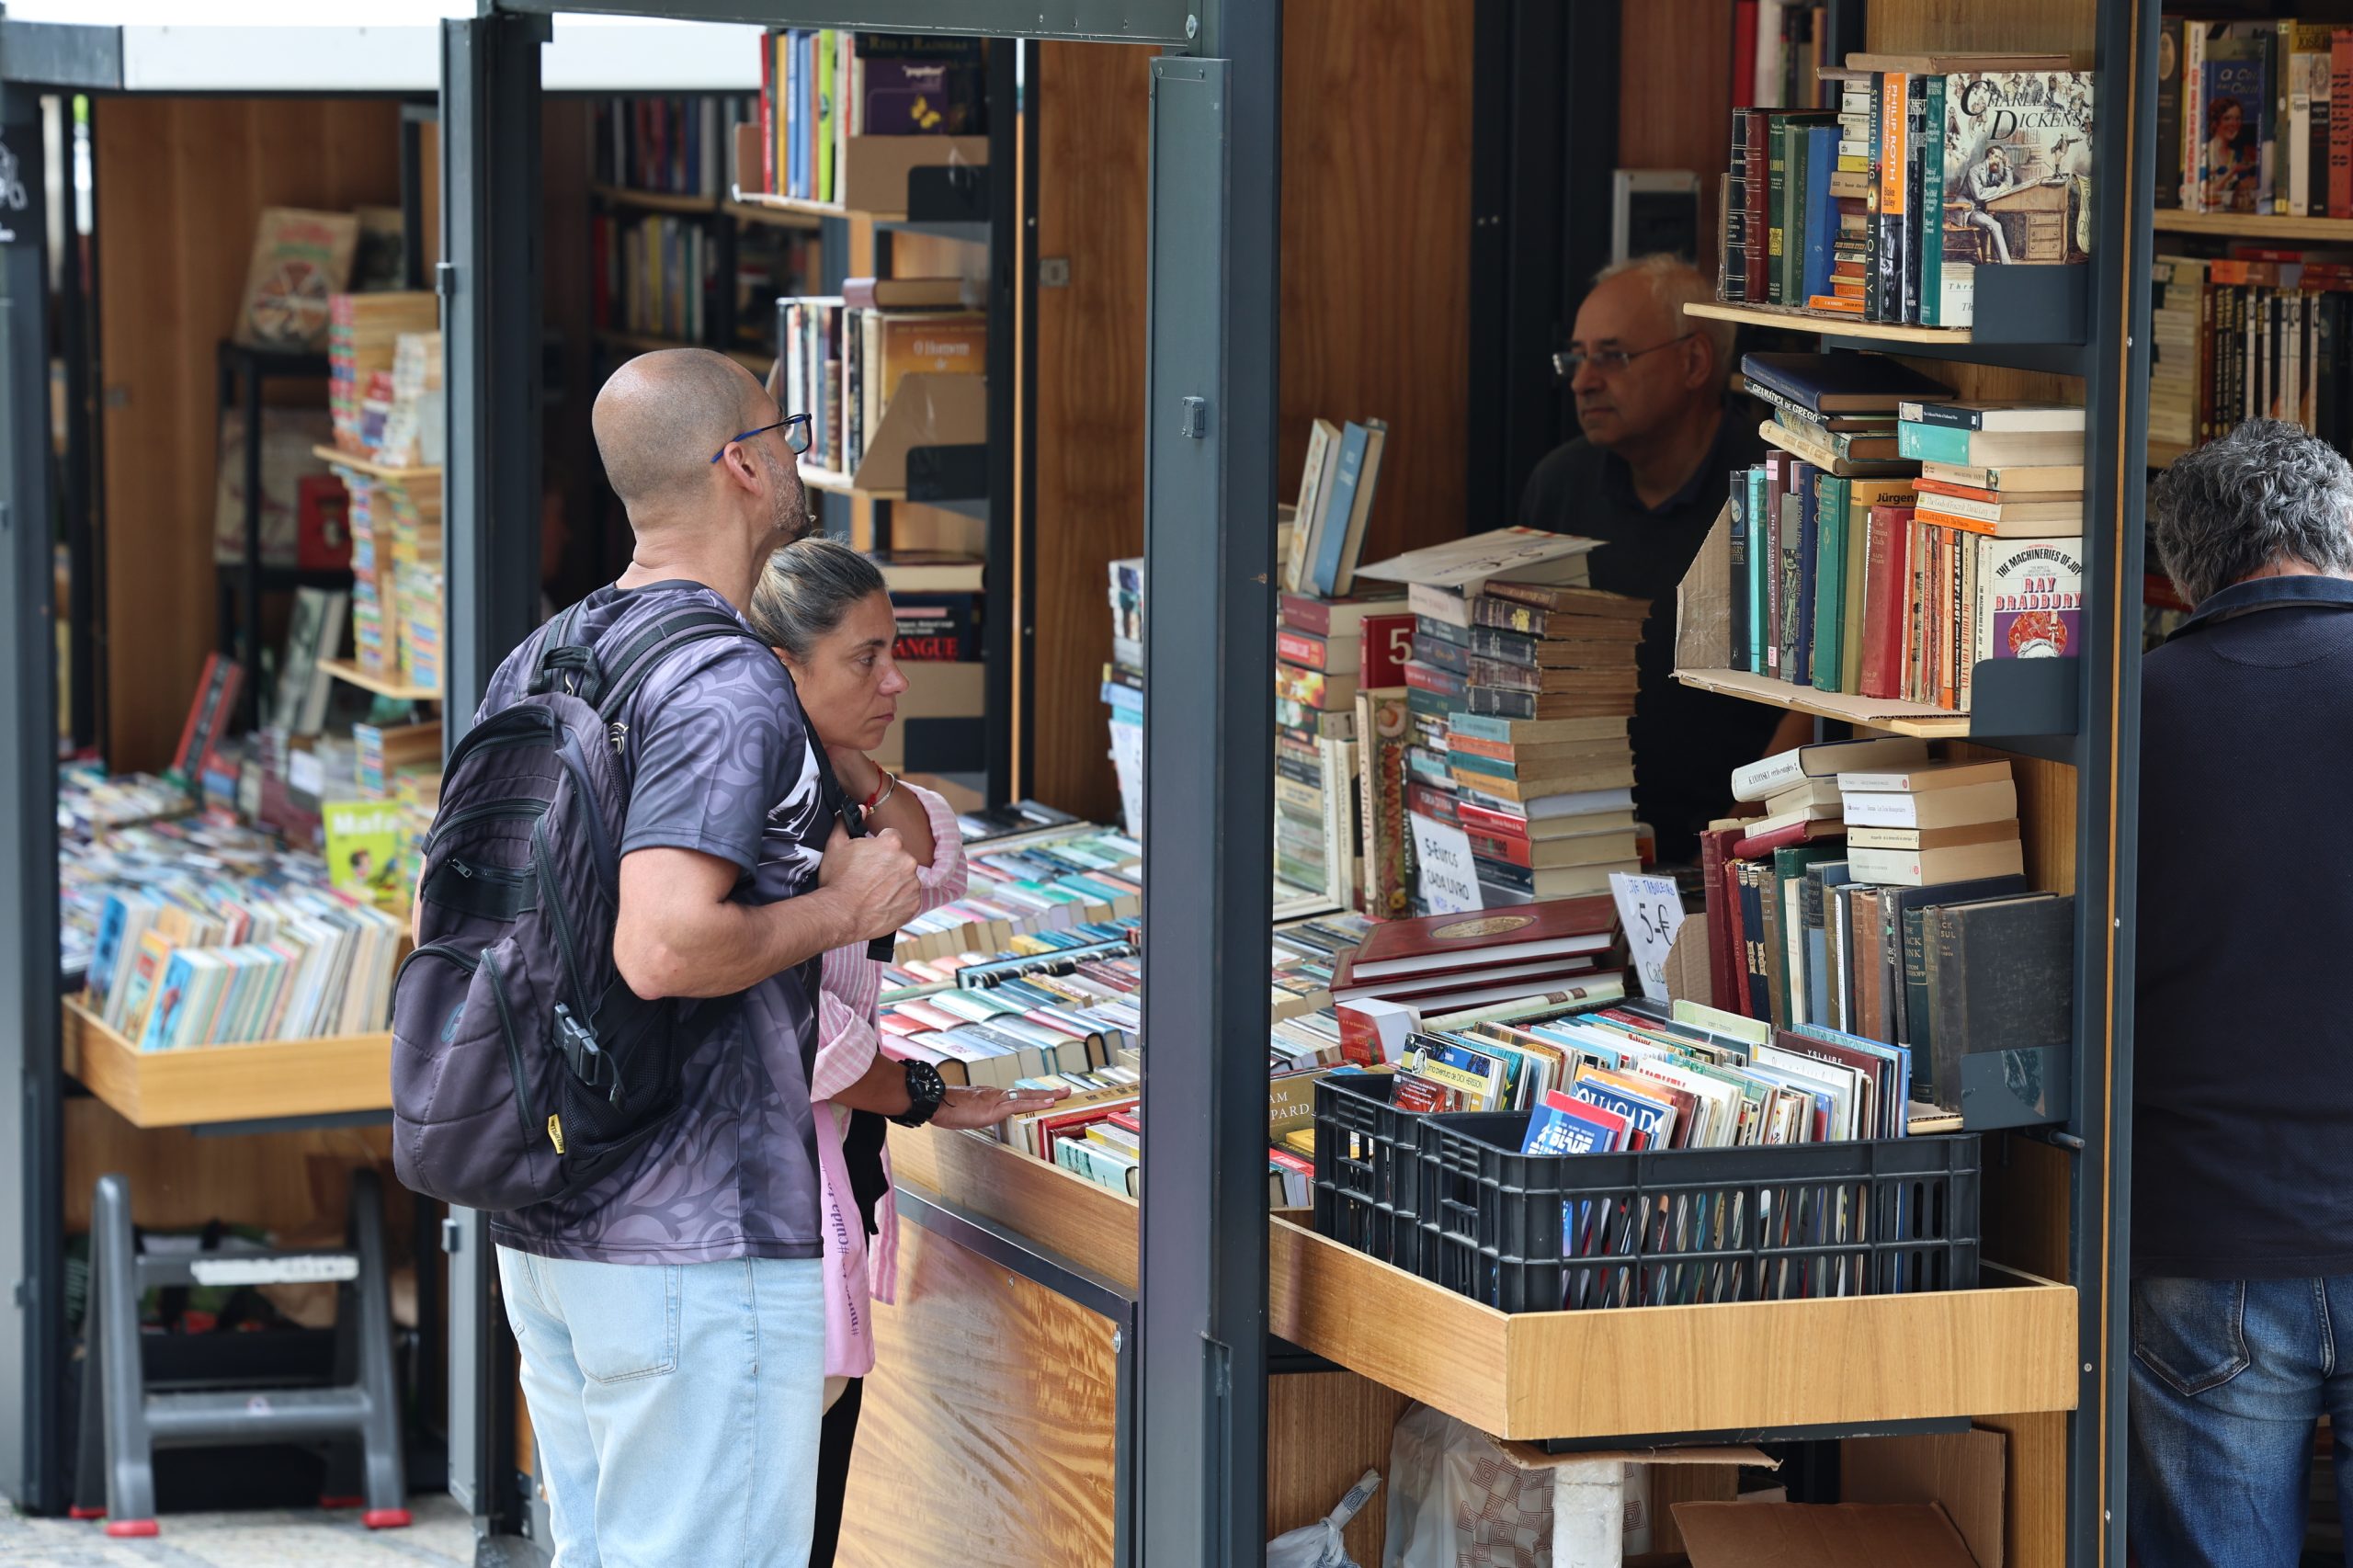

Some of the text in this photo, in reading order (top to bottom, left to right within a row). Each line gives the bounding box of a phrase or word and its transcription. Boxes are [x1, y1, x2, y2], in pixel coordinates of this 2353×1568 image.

[1961, 80, 2052, 116] CHARLES
[1870, 89, 1878, 144] STEPHEN
[1988, 109, 2082, 140] DICKENS
[1889, 85, 1898, 181] PHILIP ROTH
[1883, 186, 1895, 197] Blake
[1883, 199, 1895, 210] Bailey
[1961, 302, 1973, 312] Th
[1752, 383, 1784, 406] GRAMÁTICA
[1792, 403, 1818, 423] GREGO
[1876, 493, 1915, 505] Jürgen
[1995, 548, 2083, 578] THE MACHINERIES OF JOY
[2024, 577, 2056, 593] RAY
[1995, 593, 2082, 610] BRADBURY
[892, 637, 958, 659] ANGUE
[1389, 628, 1413, 665] 5
[1961, 648, 1970, 688] COUNTRY
[1905, 937, 1922, 946] ACK
[1905, 949, 1922, 958] ONK
[1807, 1049, 1843, 1064] YSLAIRE
[1436, 1066, 1450, 1079] aventura
[1456, 1074, 1465, 1083] DICK
[1269, 1091, 1288, 1103] AM
[1271, 1103, 1310, 1120] PARD
[1549, 1126, 1594, 1153] BLADE
